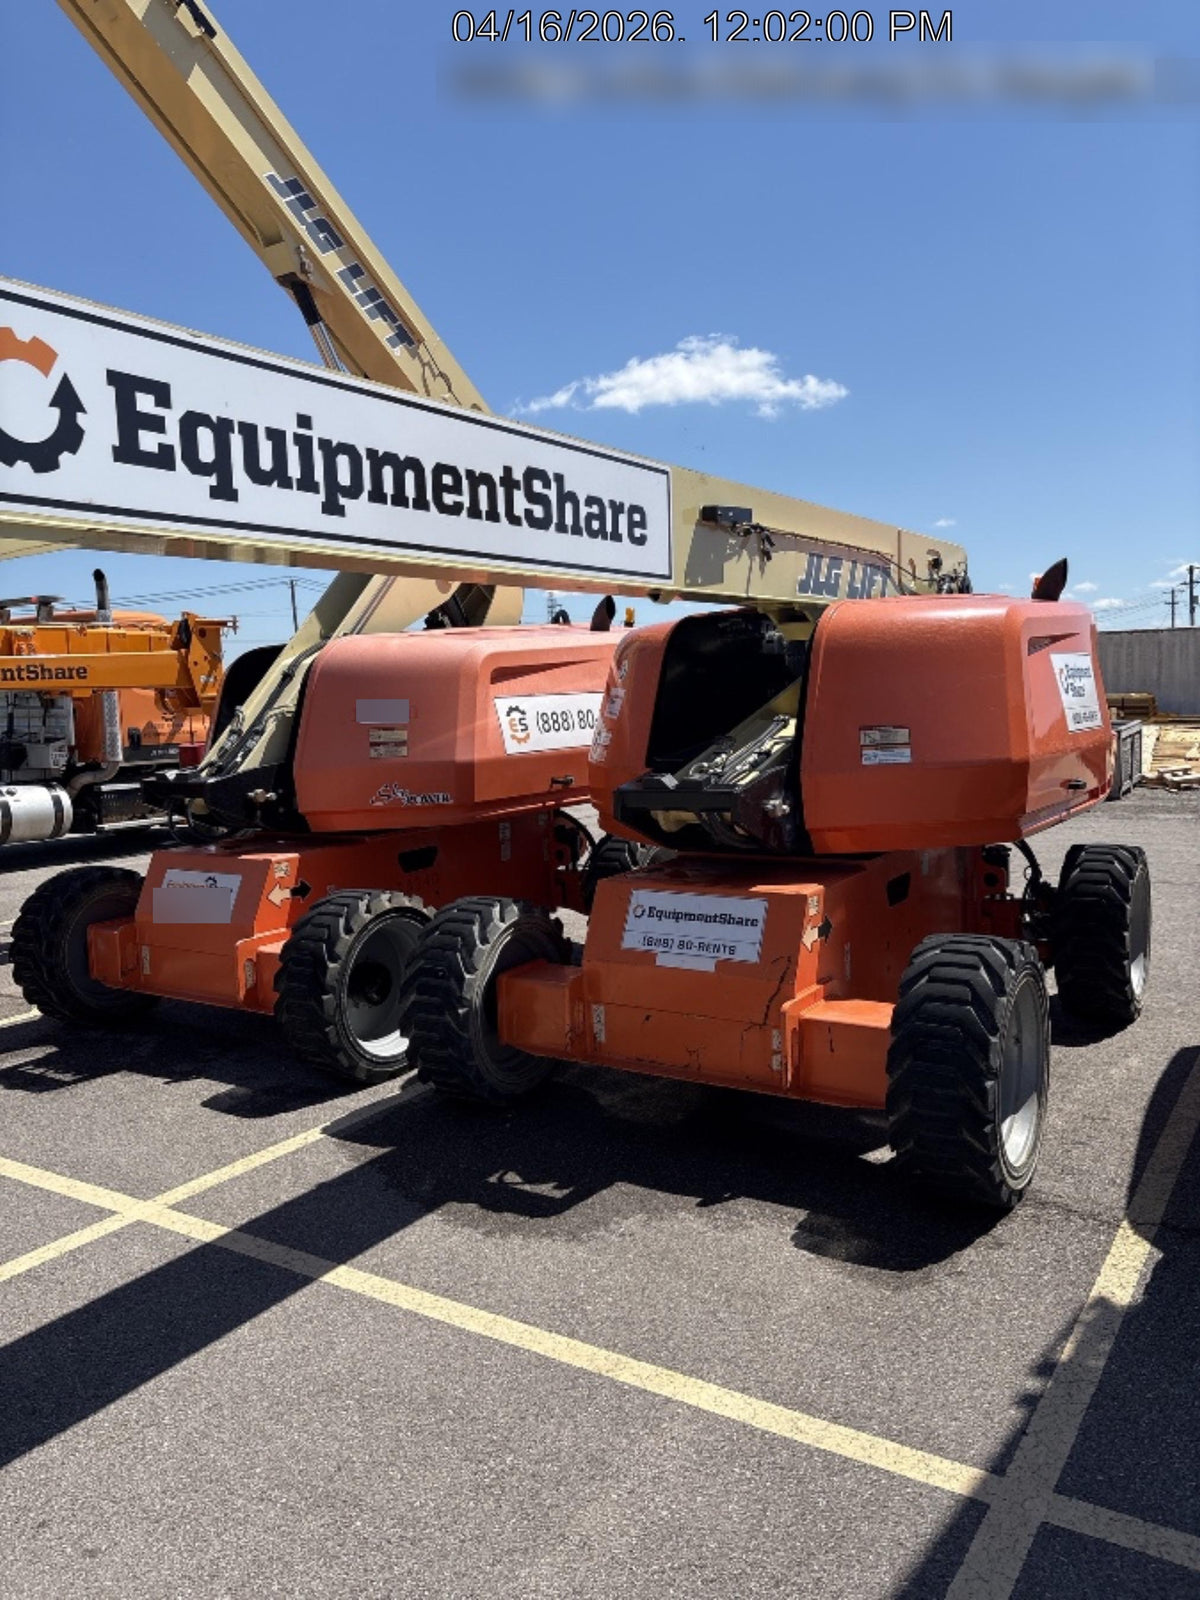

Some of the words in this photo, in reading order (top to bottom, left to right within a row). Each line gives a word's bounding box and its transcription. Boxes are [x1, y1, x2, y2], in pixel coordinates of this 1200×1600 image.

[263, 172, 347, 257] JLG
[335, 261, 416, 355] LIFT
[106, 368, 648, 547] EquipmentShare
[797, 553, 845, 599] JLG
[847, 560, 892, 599] LIFT
[536, 710, 575, 734] (888)
[647, 905, 759, 928] EquipmentShare
